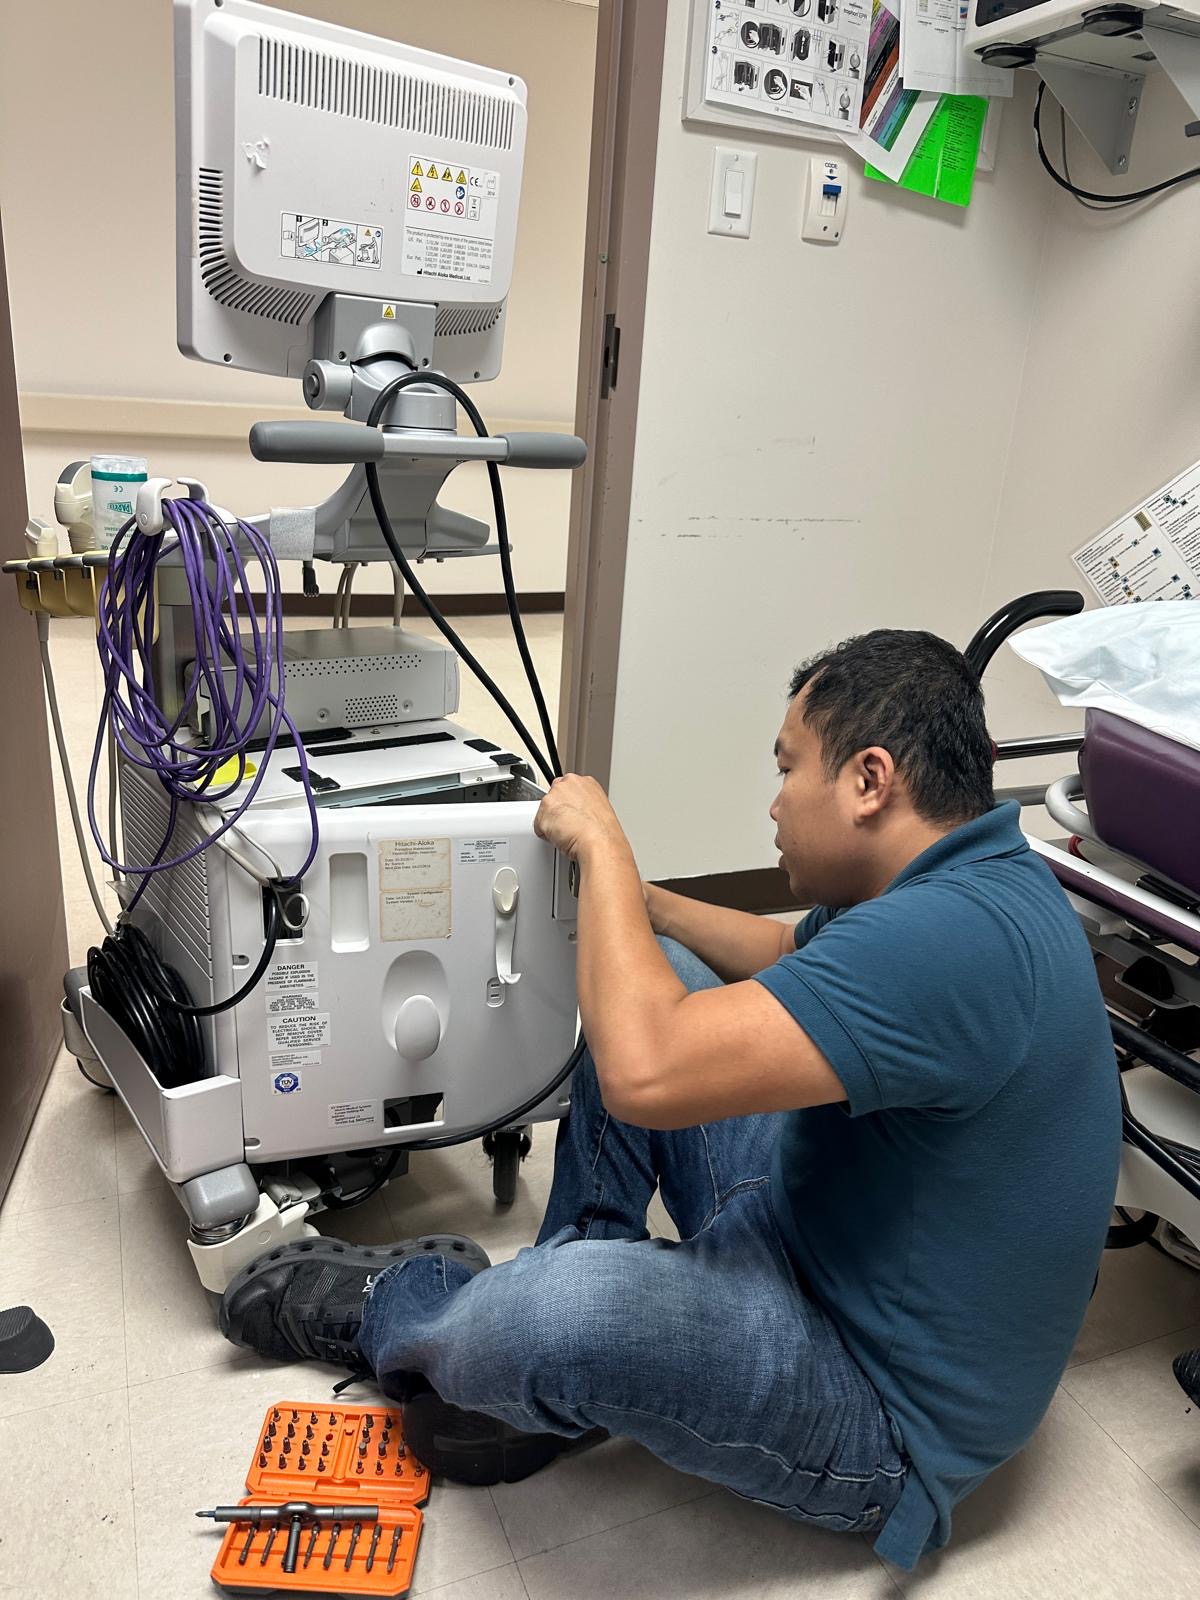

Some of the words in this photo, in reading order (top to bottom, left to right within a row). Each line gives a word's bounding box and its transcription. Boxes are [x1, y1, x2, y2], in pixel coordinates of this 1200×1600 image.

[715, 0, 721, 9] 2
[712, 46, 718, 54] 3
[470, 176, 480, 187] CE
[282, 1016, 316, 1024] CAUTION
